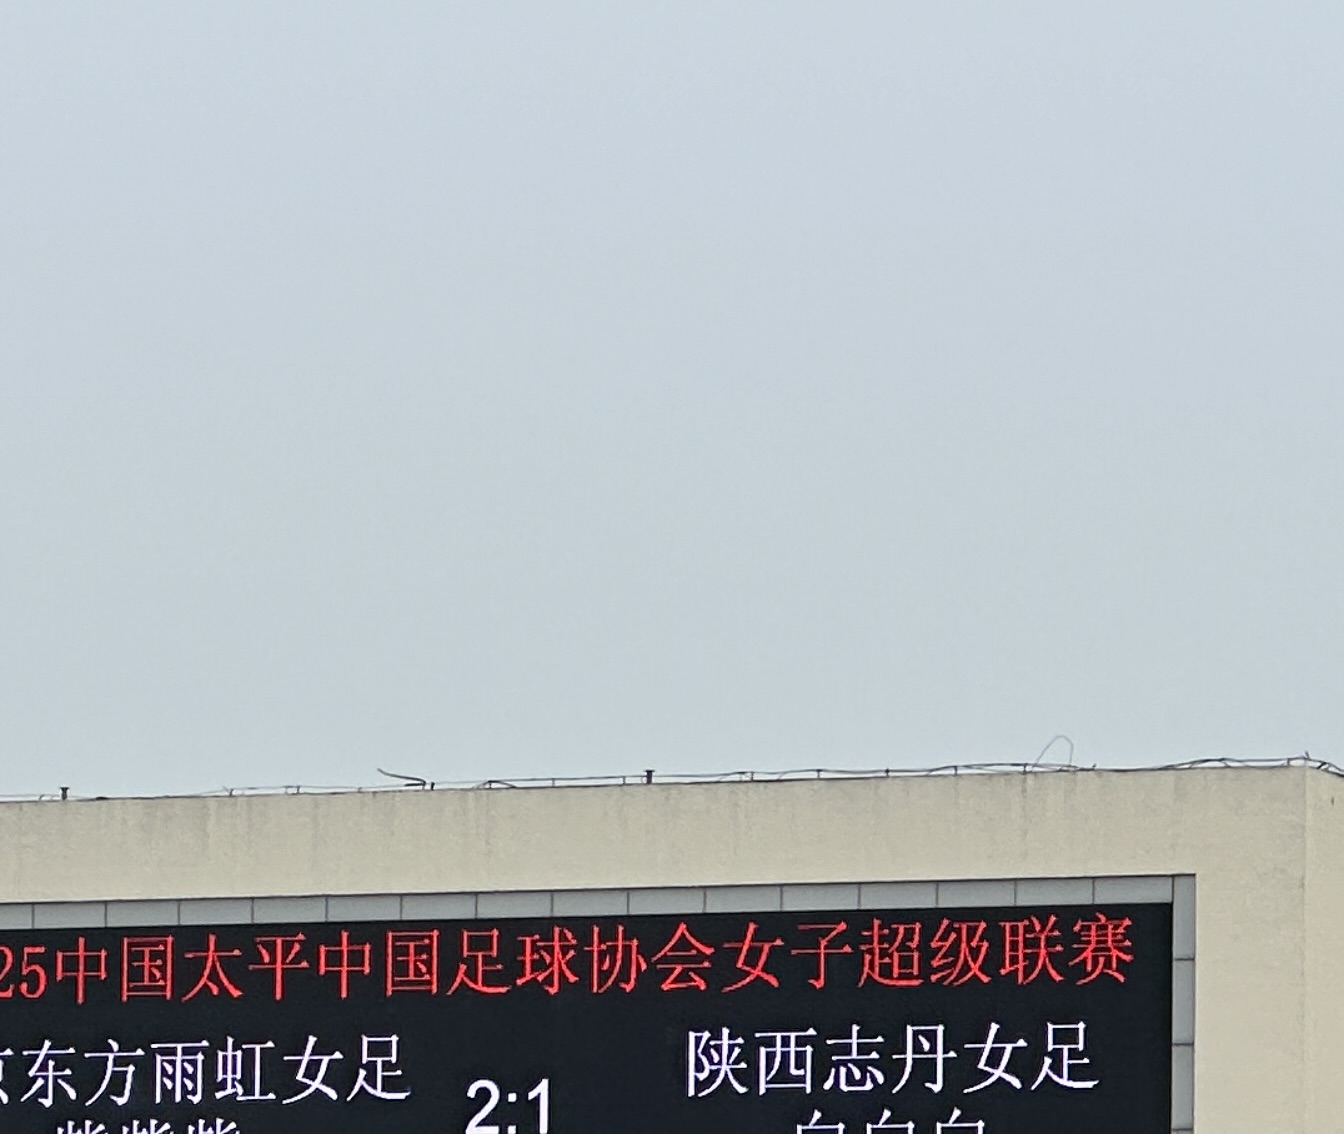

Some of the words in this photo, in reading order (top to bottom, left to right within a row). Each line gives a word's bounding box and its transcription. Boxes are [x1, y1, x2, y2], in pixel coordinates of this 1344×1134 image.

[686, 1020, 1100, 1098] 陕西志丹女足
